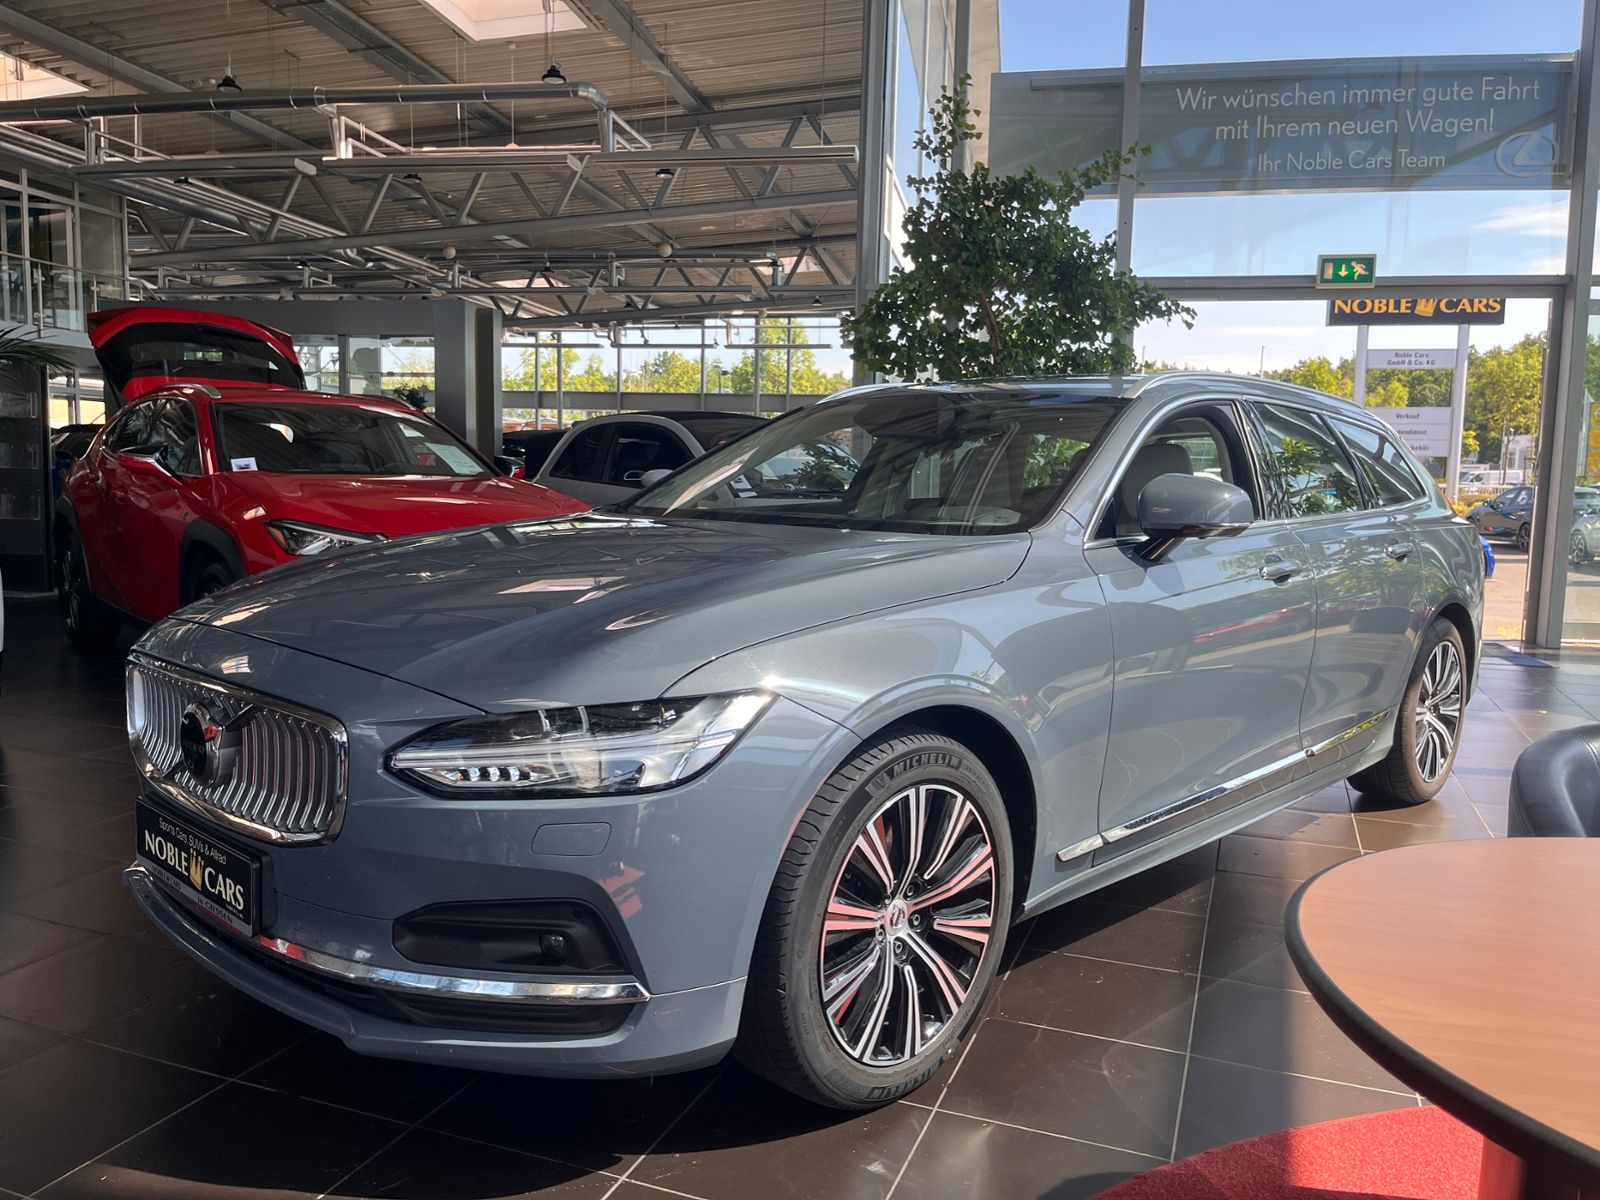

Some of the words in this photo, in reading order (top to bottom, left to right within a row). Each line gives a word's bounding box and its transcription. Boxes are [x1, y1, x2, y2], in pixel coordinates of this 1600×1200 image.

[1176, 87, 1217, 112] Wir
[1222, 82, 1336, 109] wünschen
[1343, 83, 1417, 104] immer
[1422, 80, 1474, 107] gute
[1481, 76, 1541, 101] Fahrt
[1215, 119, 1249, 141] mit
[1256, 115, 1321, 139] Ihrem
[1328, 117, 1398, 136] neuen
[1406, 108, 1495, 138] Wagen!
[1258, 152, 1281, 172] Ihr
[1286, 150, 1343, 171] Noble
[1348, 150, 1393, 170] Cars
[1398, 148, 1446, 169] Team
[1334, 299, 1412, 314] NOBLE
[1439, 298, 1502, 313] CARS
[892, 752, 961, 777] MICHELIN
[145, 829, 189, 877] NOBLE
[204, 866, 245, 911] CARS
